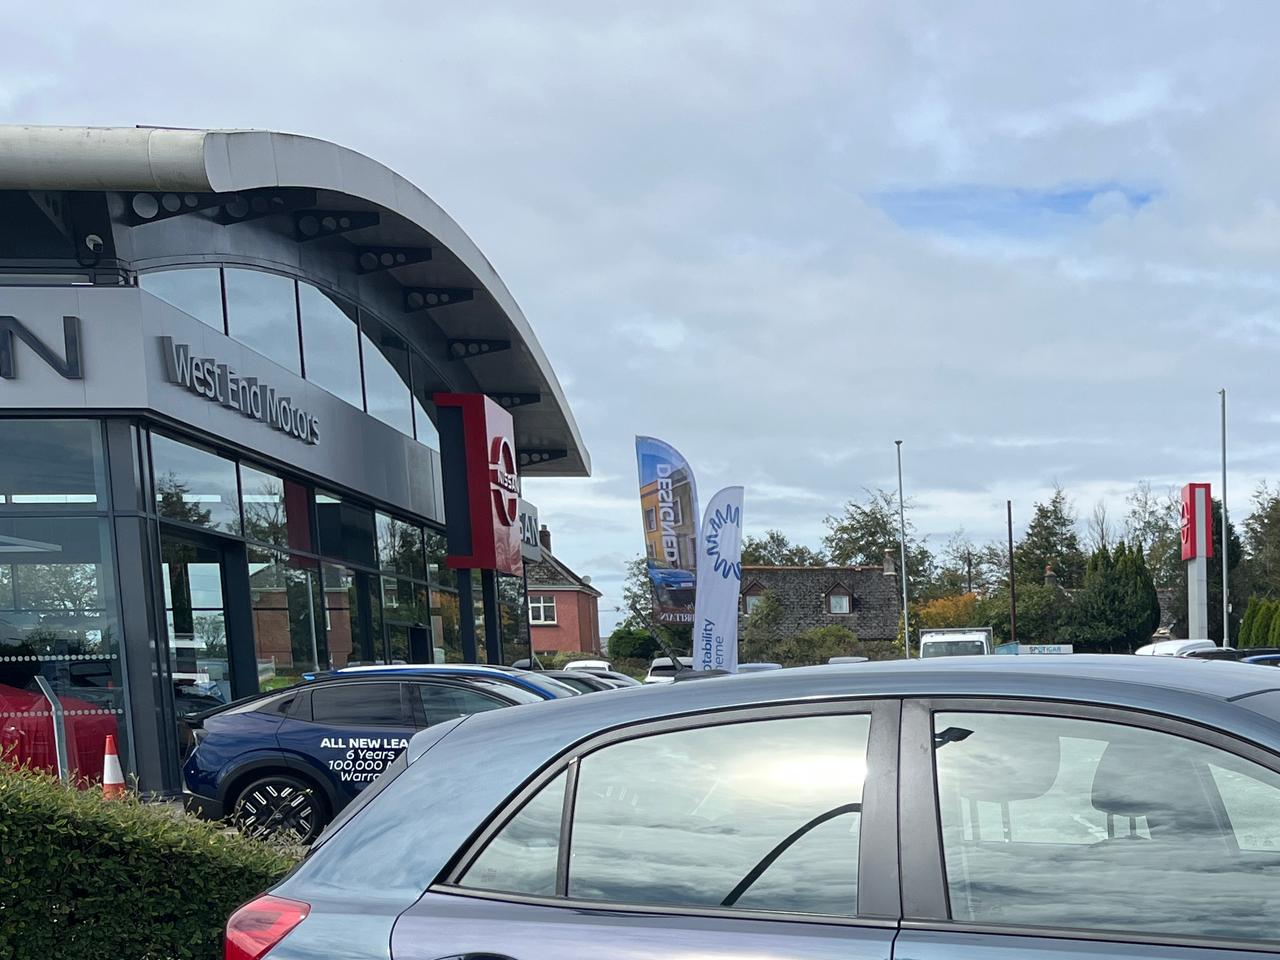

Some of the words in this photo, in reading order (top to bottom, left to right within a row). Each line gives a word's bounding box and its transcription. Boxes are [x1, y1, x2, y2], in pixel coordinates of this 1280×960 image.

[165, 338, 224, 402] West
[226, 370, 263, 419] End
[266, 386, 321, 445] Motors
[320, 739, 346, 748] ALL
[349, 739, 380, 748] NEW
[346, 750, 354, 760] 6
[358, 750, 395, 760] Years
[329, 760, 382, 773] 100,000
